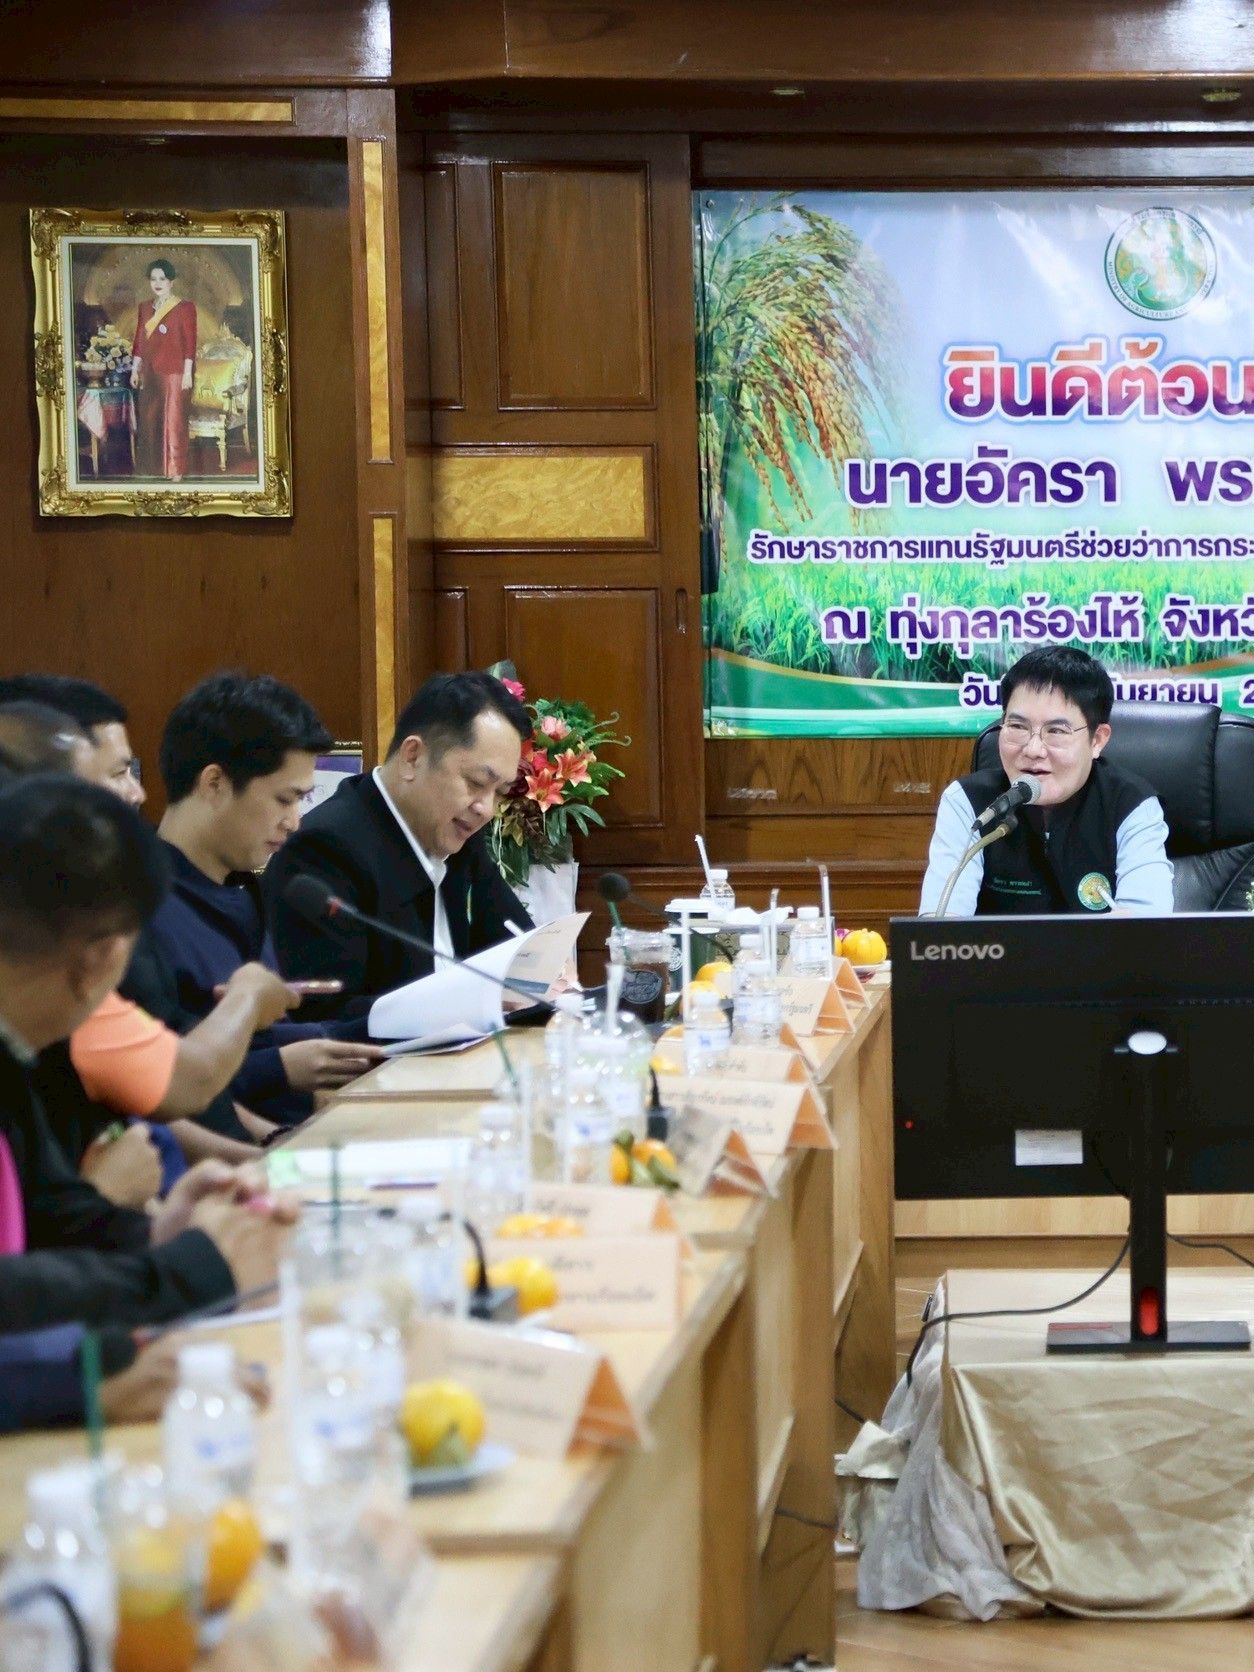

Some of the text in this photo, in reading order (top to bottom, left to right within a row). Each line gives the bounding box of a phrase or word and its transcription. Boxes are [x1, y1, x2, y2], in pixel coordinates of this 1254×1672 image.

[847, 445, 1117, 504] นายอัครา
[824, 609, 867, 640] ณ
[889, 595, 1141, 656] ทุ่งกุลาร้องไห้
[963, 675, 1003, 706] วัน
[1112, 677, 1219, 703] นยายน
[910, 940, 1005, 961] Lenovo
